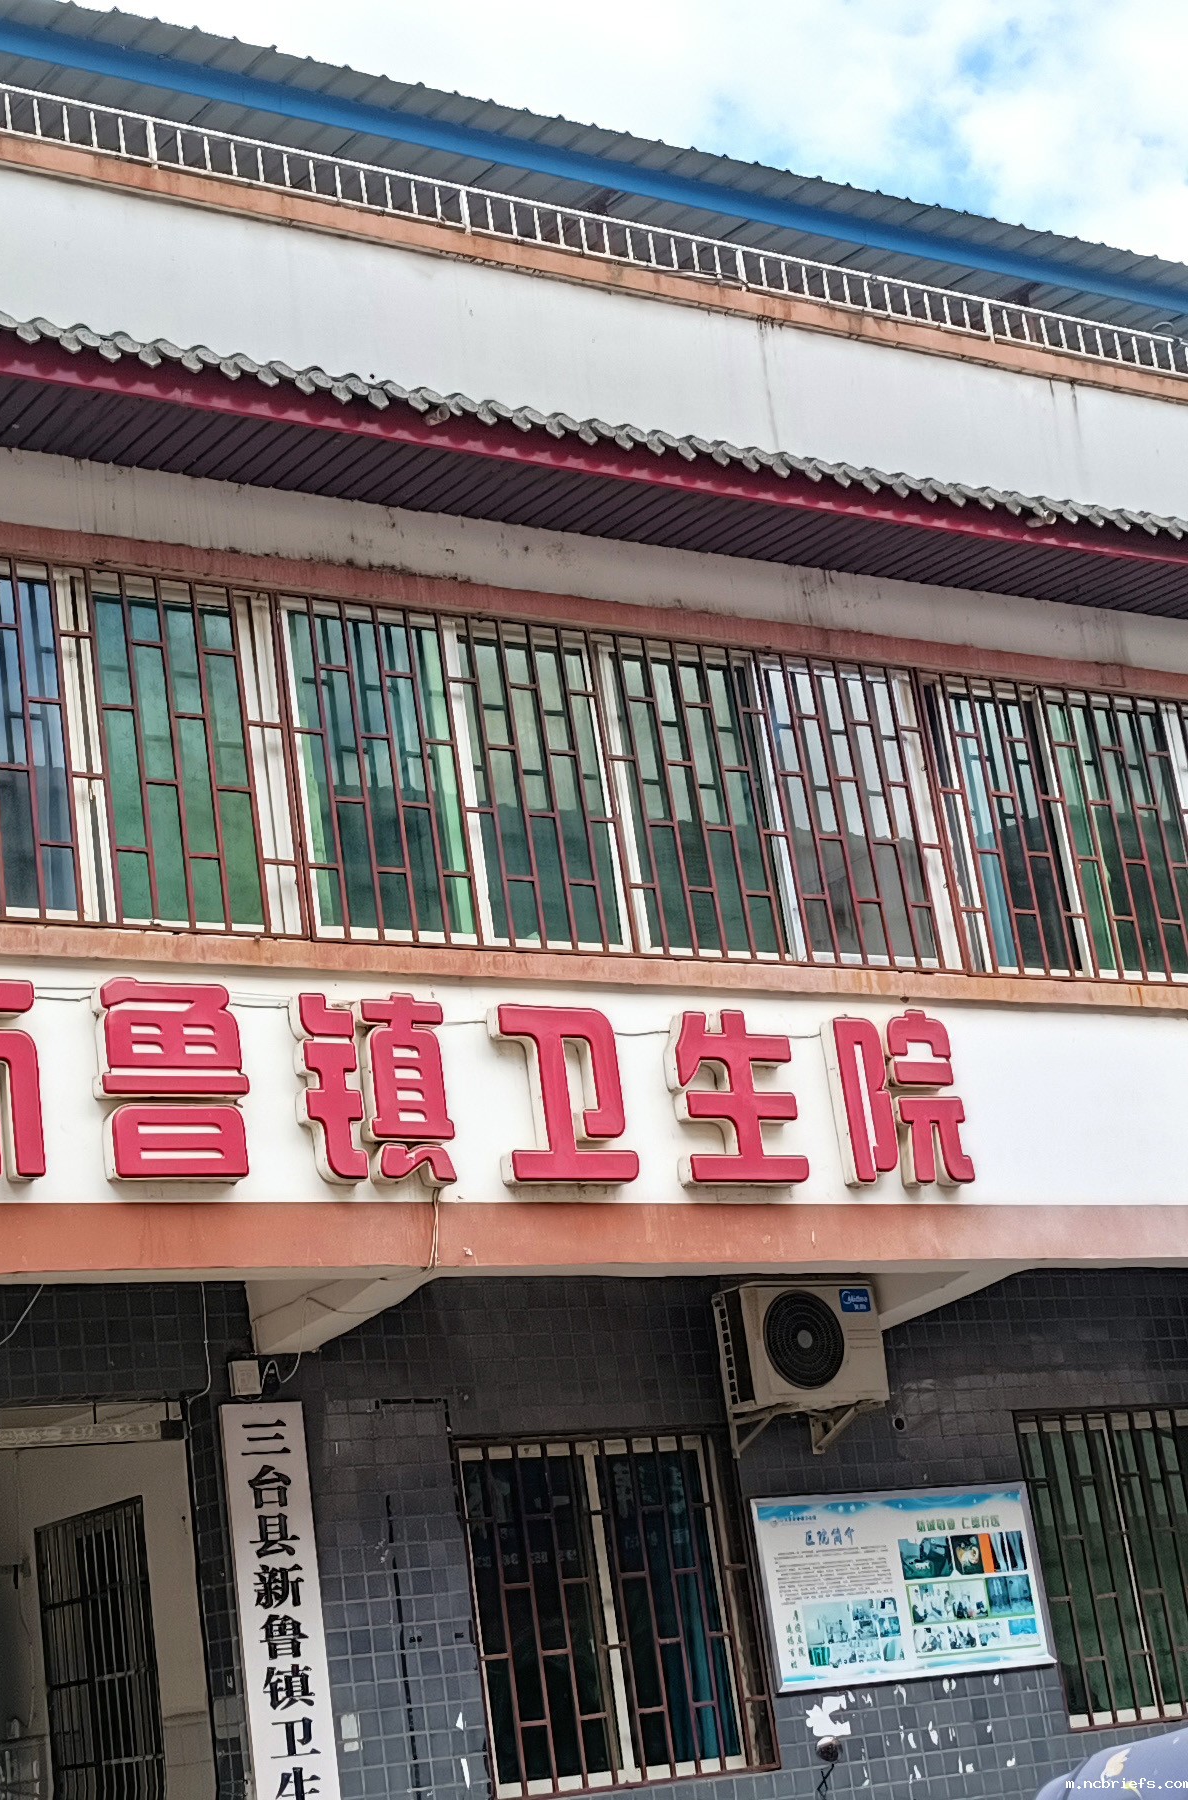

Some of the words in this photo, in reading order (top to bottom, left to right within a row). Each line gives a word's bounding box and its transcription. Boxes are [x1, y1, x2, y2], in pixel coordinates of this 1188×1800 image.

[241, 1419, 322, 1800] 三台县新鲁镇卫生
